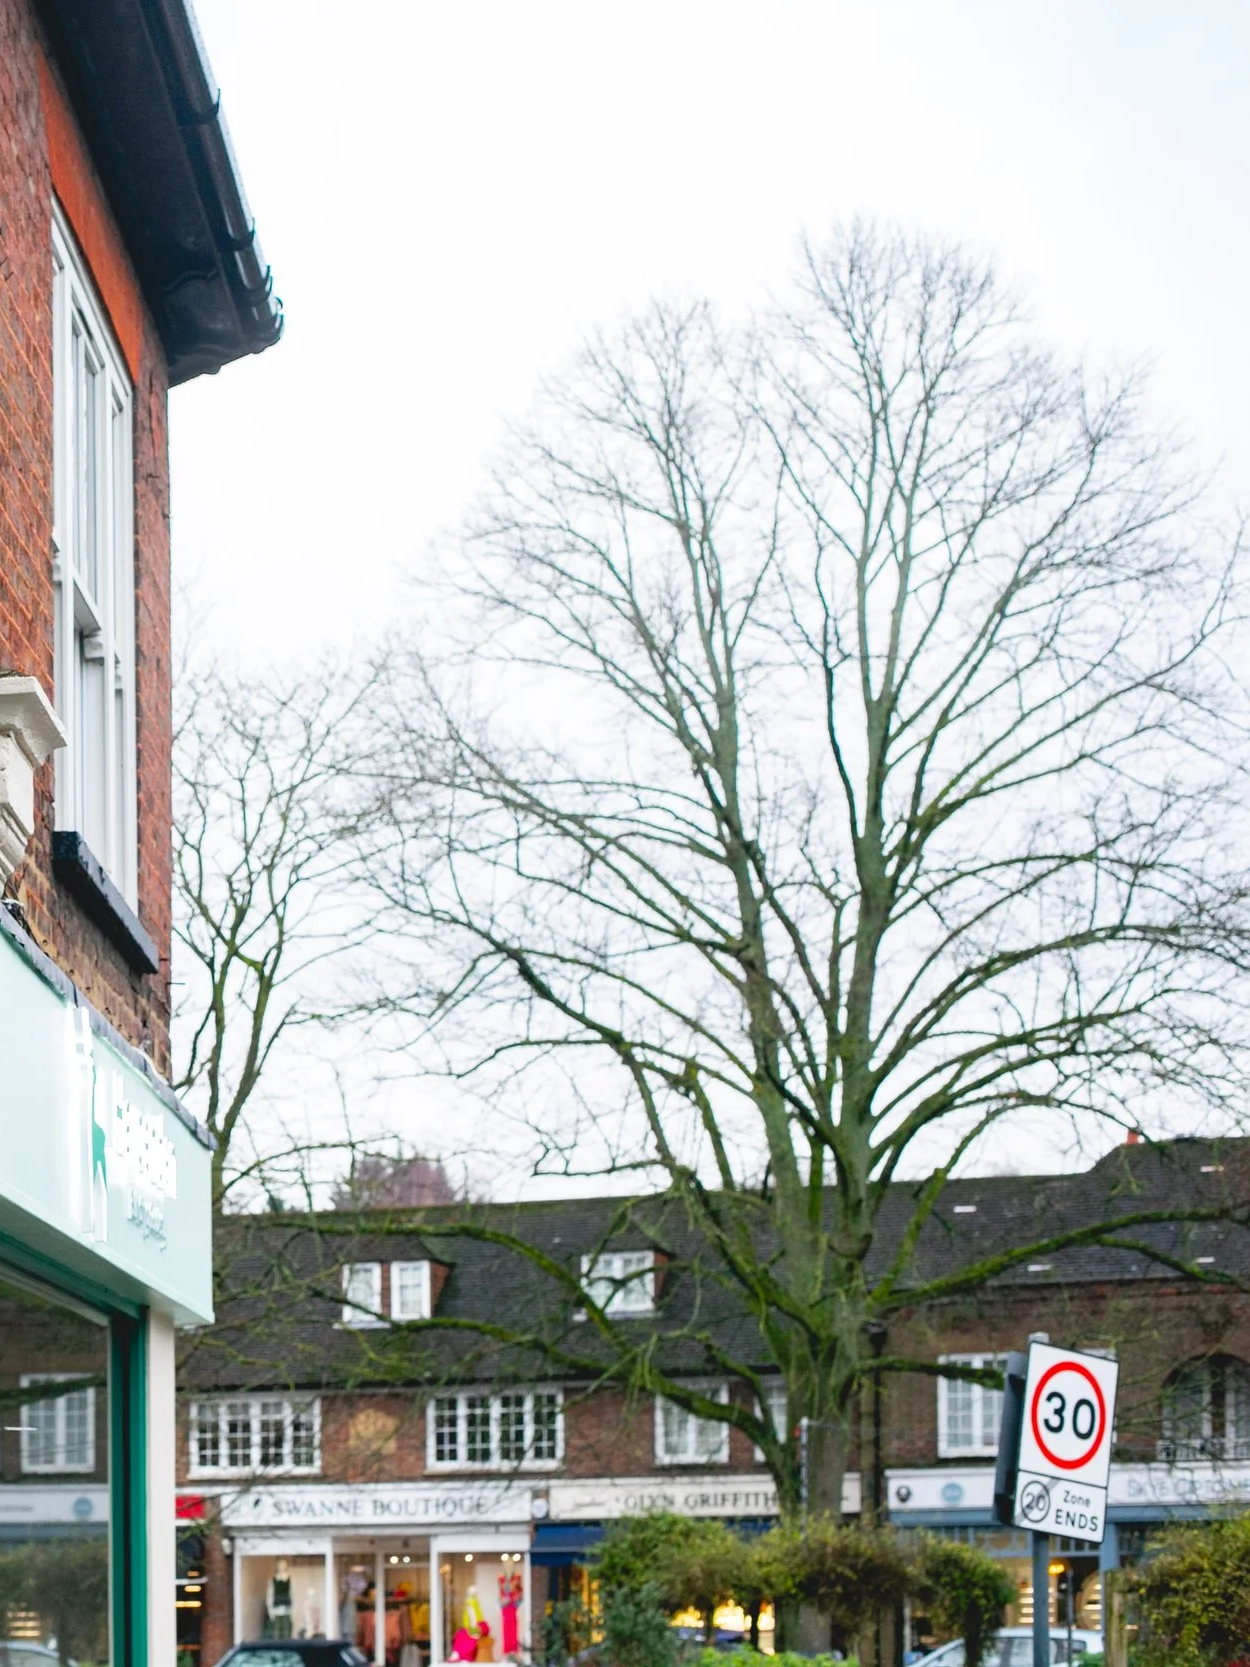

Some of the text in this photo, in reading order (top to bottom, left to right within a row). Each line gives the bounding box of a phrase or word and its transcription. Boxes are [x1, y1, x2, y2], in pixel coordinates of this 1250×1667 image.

[1043, 1391, 1097, 1440] 30
[272, 1497, 490, 1517] SWANNE BOUTIQUE
[1025, 1492, 1046, 1512] 20
[1064, 1490, 1091, 1507] Zone
[1055, 1509, 1098, 1532] ENDS
